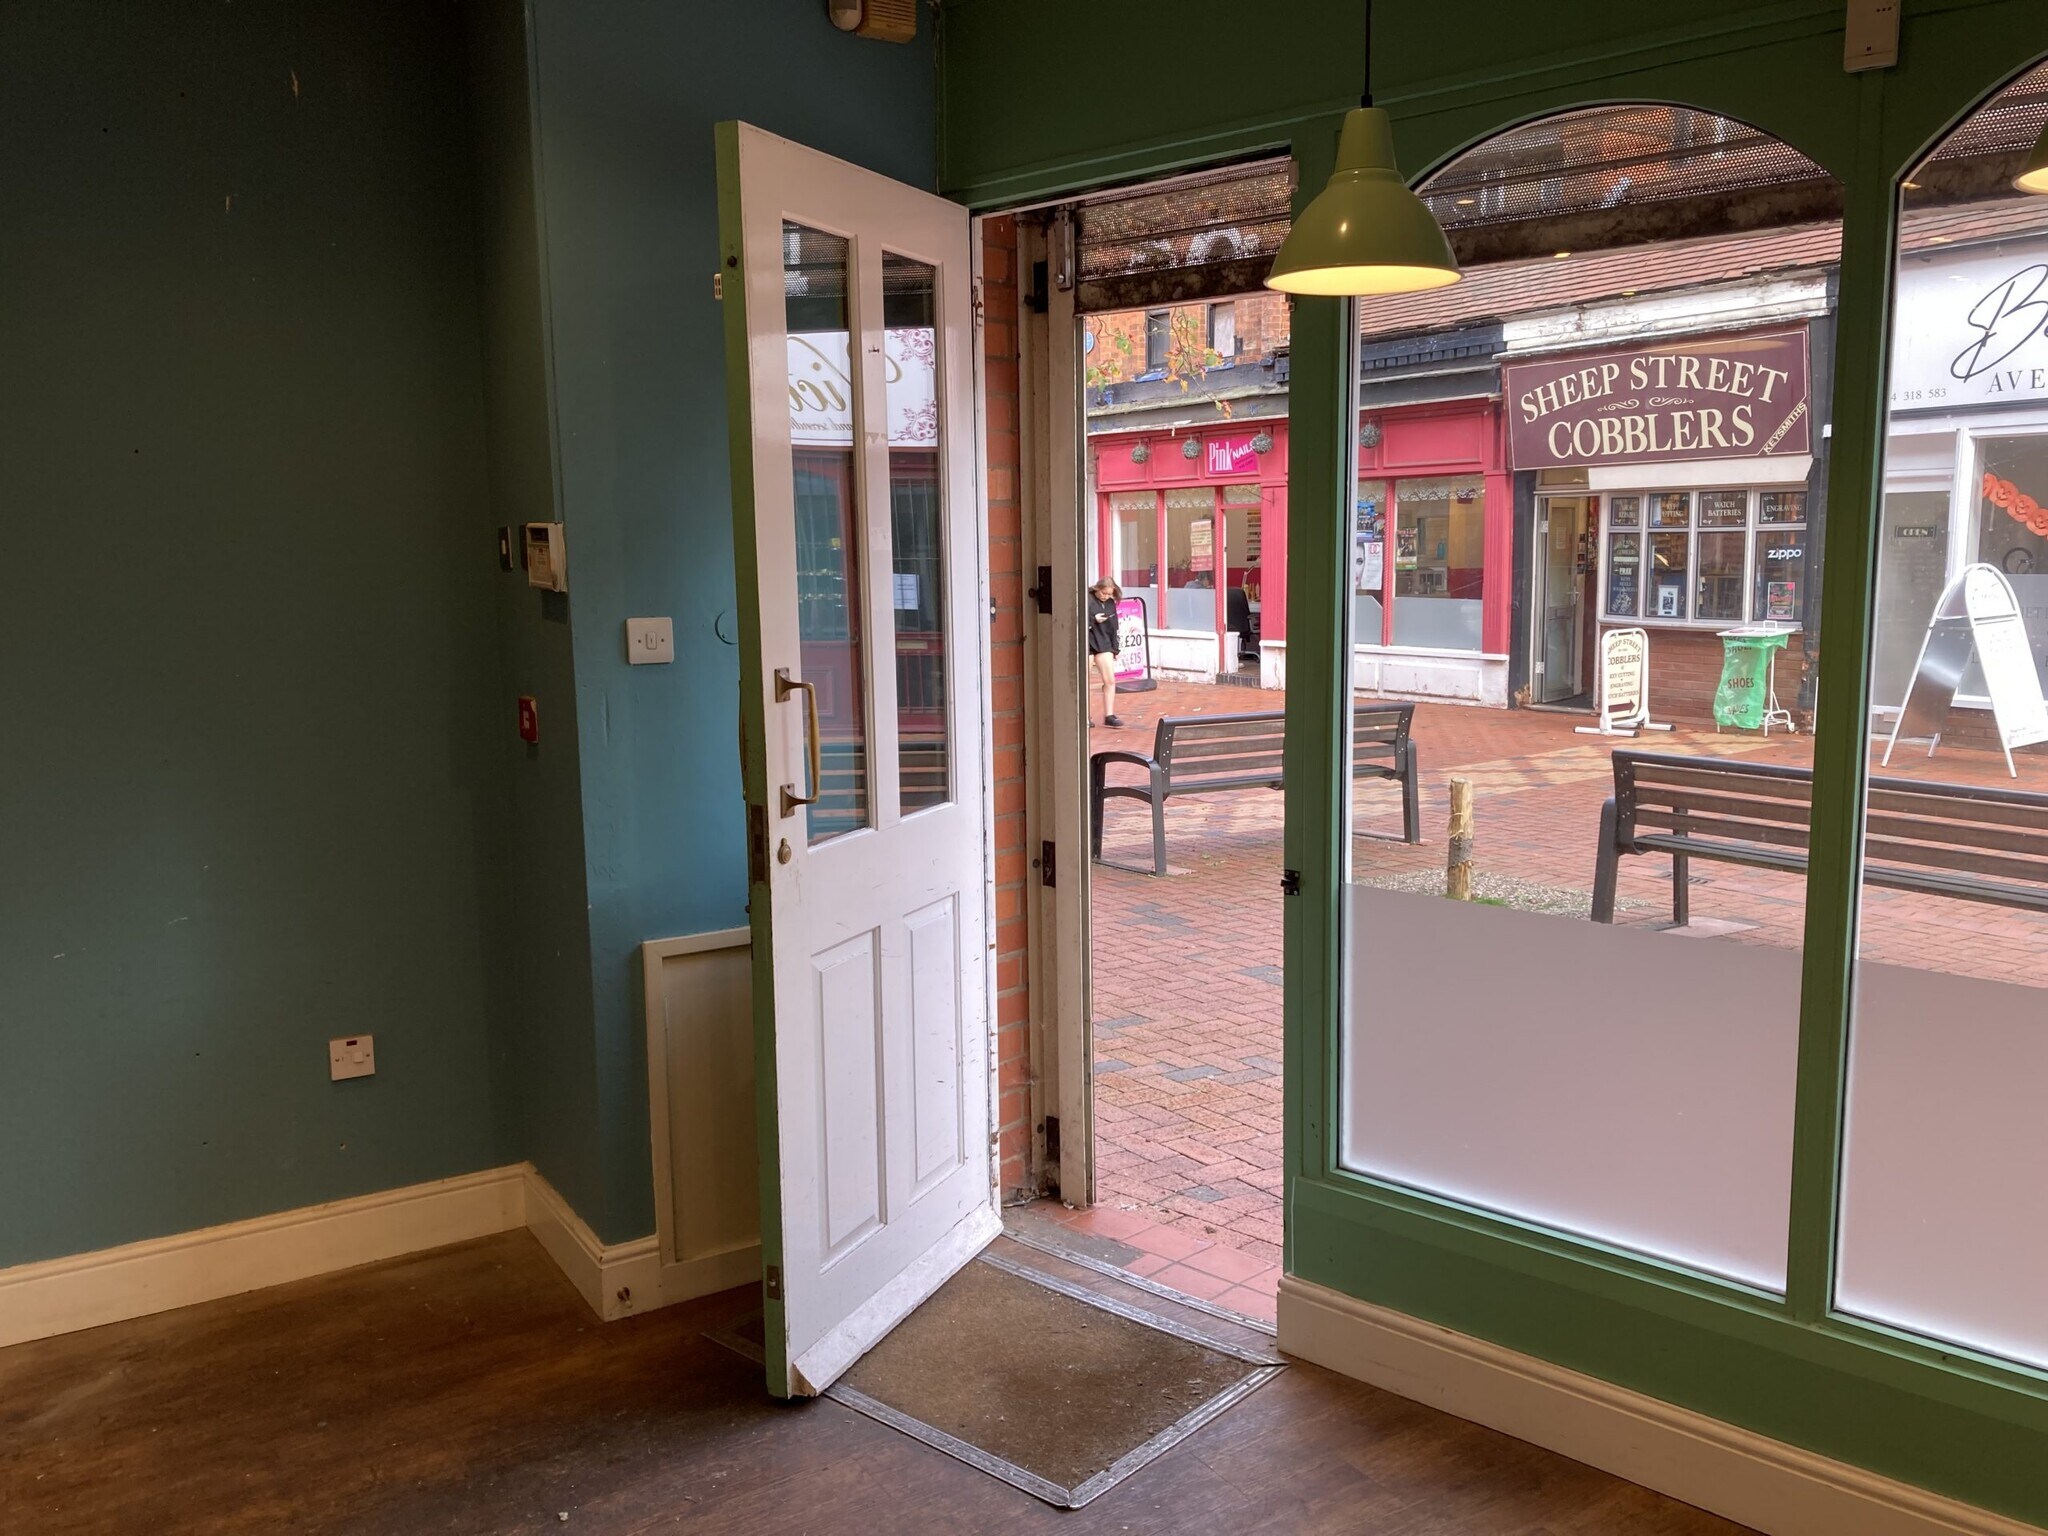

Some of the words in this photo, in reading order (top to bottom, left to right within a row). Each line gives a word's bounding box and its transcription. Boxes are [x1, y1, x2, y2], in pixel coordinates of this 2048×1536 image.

[1520, 362, 1620, 424] SHEEP
[1629, 354, 1789, 404] STREET
[1903, 390, 1922, 401] 318
[1928, 387, 1947, 398] 583
[1548, 404, 1755, 459] COBBLERS
[1763, 401, 1808, 454] KEYSMITHS
[1208, 441, 1233, 472] Pink
[1714, 501, 1736, 509] WATCH
[1766, 504, 1803, 513] ENGRAVING
[1707, 508, 1742, 517] BATTERIES
[1903, 528, 1928, 536] OPEN
[1125, 633, 1142, 648] £20
[1622, 638, 1641, 653] STREET
[1130, 652, 1142, 664] £15
[1727, 677, 1755, 688] SHOES
